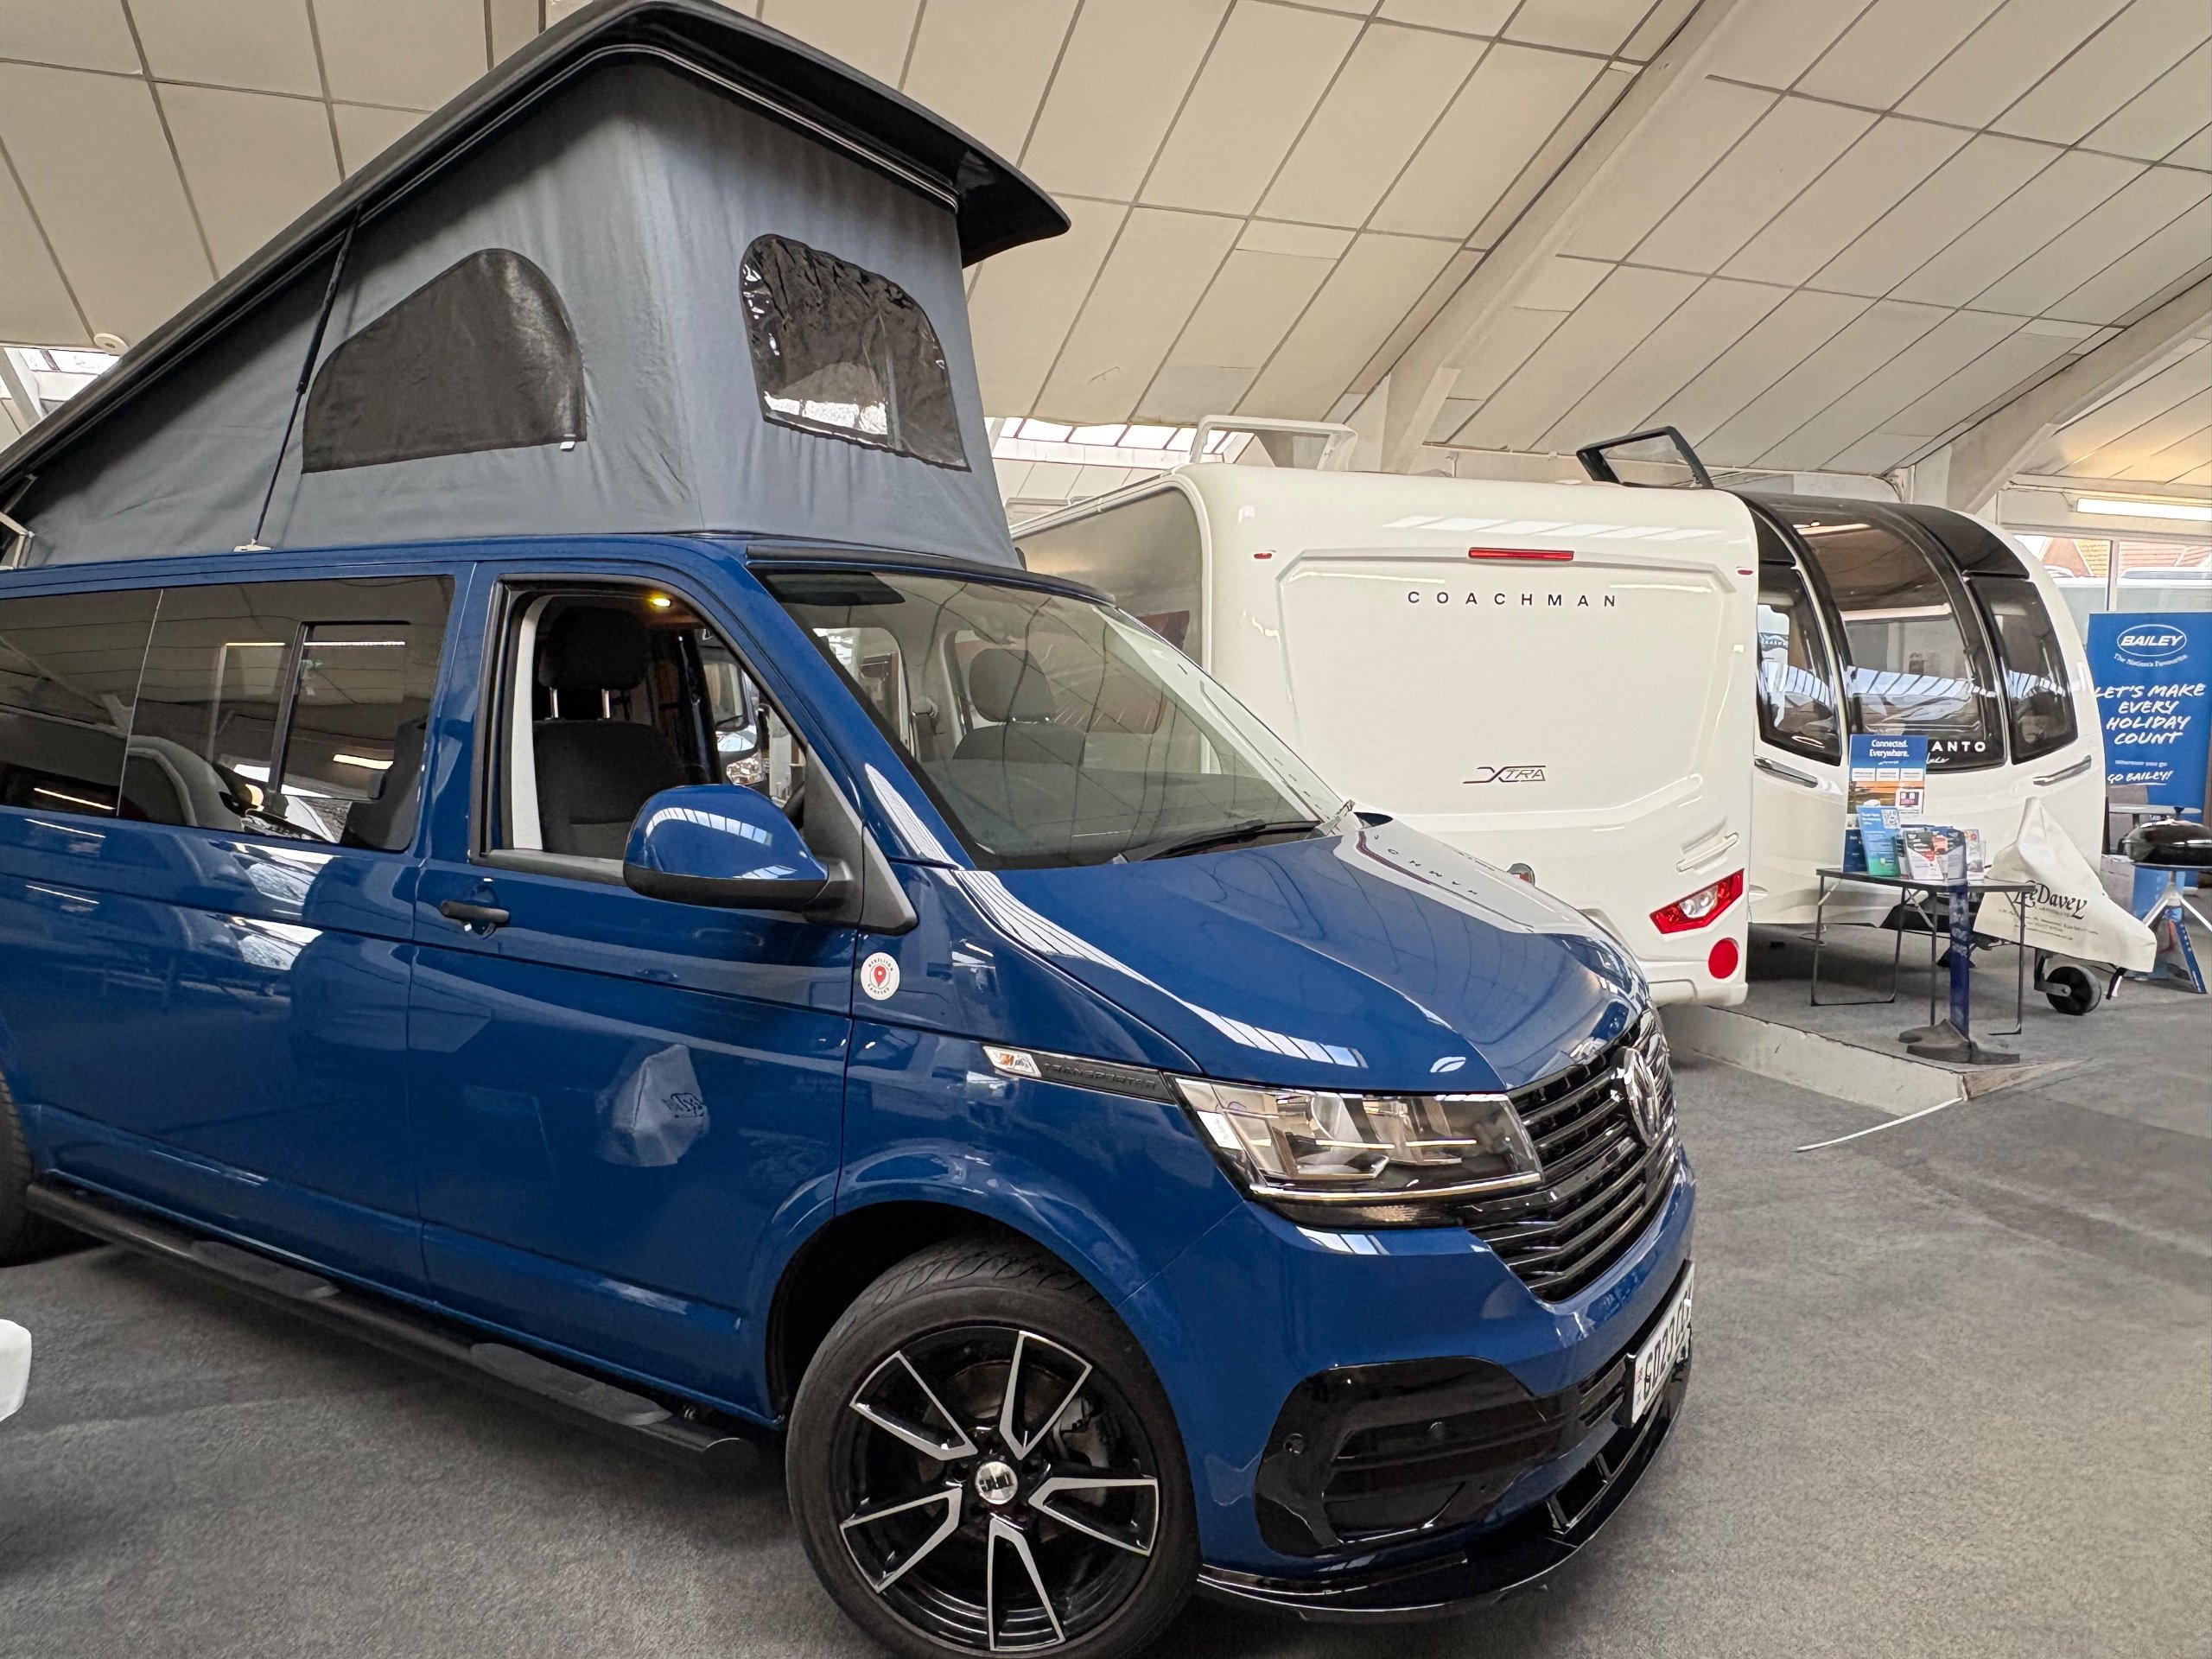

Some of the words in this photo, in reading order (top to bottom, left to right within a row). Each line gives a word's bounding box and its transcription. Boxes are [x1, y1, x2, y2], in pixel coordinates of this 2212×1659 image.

[1408, 591, 1615, 607] COACHMAN
[2120, 635, 2183, 646] BAILEY
[2094, 685, 2145, 699] LET'S
[2147, 683, 2207, 698] MAKE
[2118, 700, 2179, 715] EVERY
[2106, 715, 2192, 731] HOLIDAY
[1871, 739, 1909, 748] Connected.
[2113, 731, 2183, 745] COUNT
[1869, 748, 1910, 759] Everywhere.
[1463, 766, 1546, 784] XTRA
[2107, 773, 2124, 785] GO
[2126, 771, 2174, 782] BAILEY!
[1044, 1063, 1156, 1090] TRANSPORTER
